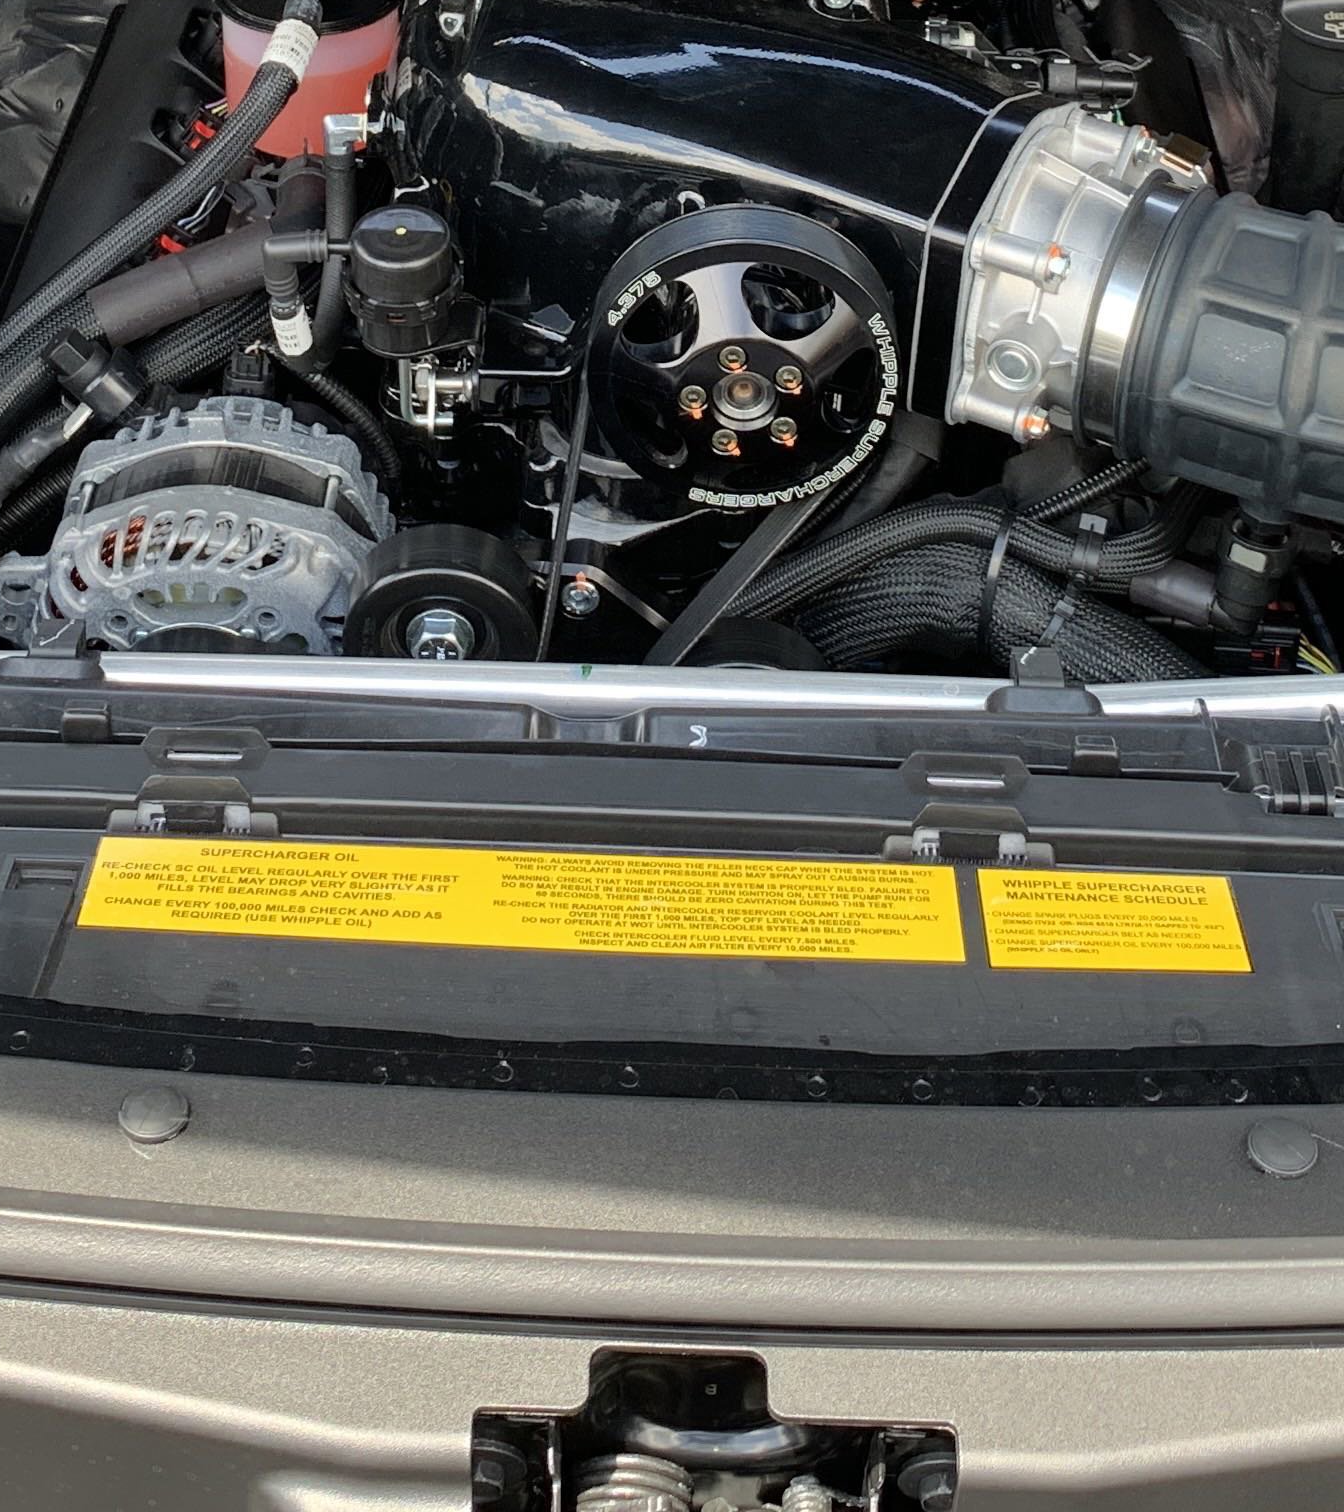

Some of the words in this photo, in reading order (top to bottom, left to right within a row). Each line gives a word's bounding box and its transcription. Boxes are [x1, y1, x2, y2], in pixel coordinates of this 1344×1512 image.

[608, 270, 662, 327] 4.375
[868, 313, 899, 416] WHIPPLE
[688, 419, 887, 508] SUPERCHARGERS
[200, 848, 329, 861] SUPERCHARGER
[334, 852, 359, 862] OIL
[102, 861, 170, 872] RE-CHECK
[172, 864, 192, 872] SC
[196, 865, 215, 873] OIL
[221, 866, 260, 875] LEVEL
[266, 868, 347, 878] REGULARLY
[350, 871, 387, 880] OVER
[393, 872, 417, 881] THE
[421, 873, 459, 883] FIRST
[156, 883, 193, 892] FILLS
[199, 885, 223, 894] THE
[227, 886, 296, 897] BEARINGS
[300, 889, 328, 898] AND
[192, 875, 231, 884] LEVEL
[237, 877, 265, 886] MAY
[268, 878, 306, 887] DROP
[310, 880, 345, 889] VERY
[349, 881, 412, 891] SLIGHTLY
[416, 884, 433, 892] AS
[437, 885, 449, 893] IT
[1002, 879, 1071, 891] WHIPPLE
[1076, 882, 1206, 894] SUPERCHARGER
[1006, 891, 1118, 903] MAINTENANCE
[1123, 894, 1208, 906] SCHEDULE
[104, 896, 161, 906] CHANGE
[165, 899, 210, 909] EVERY
[265, 904, 305, 913] MILES
[309, 906, 356, 915] CHECK
[360, 908, 388, 917] AND
[392, 909, 420, 918] ADD
[424, 911, 442, 920] AS
[170, 910, 241, 922] REQUIRED
[244, 913, 276, 923] (USE
[281, 915, 340, 927] WHIPPLE
[345, 918, 372, 928] OIL)
